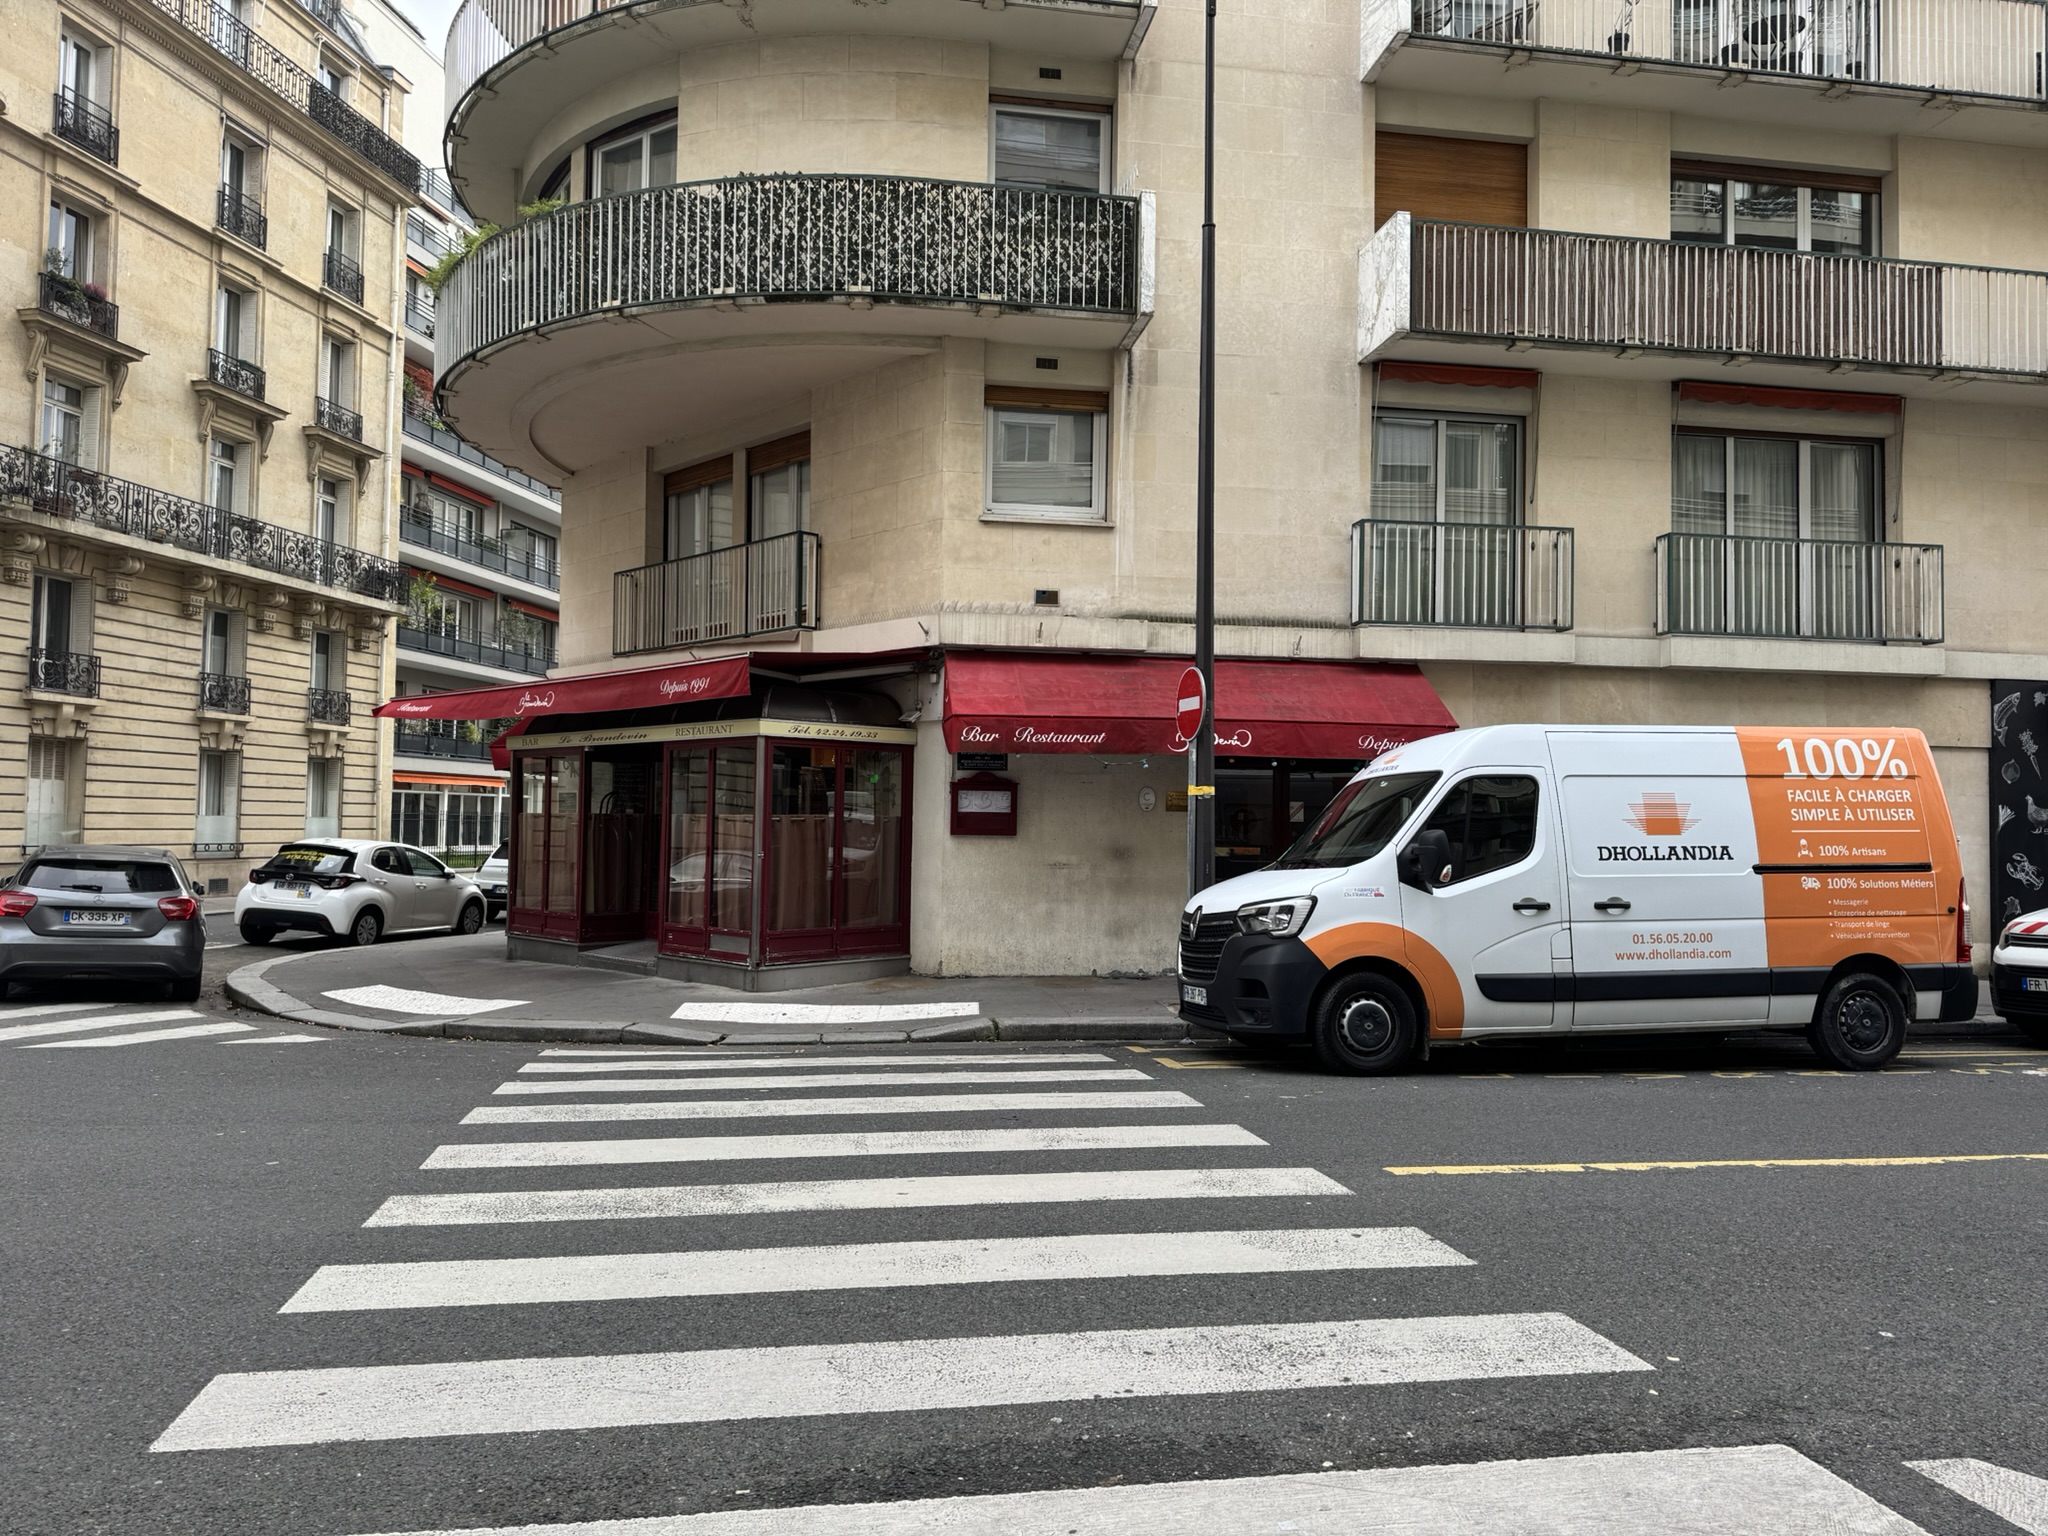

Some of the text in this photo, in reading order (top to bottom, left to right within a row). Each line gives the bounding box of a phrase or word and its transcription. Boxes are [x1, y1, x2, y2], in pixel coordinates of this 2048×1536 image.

[660, 676, 711, 699] Depuis 1991
[522, 738, 539, 747] BAR
[558, 735, 574, 744] Le
[675, 725, 734, 737] RESTAURANT
[961, 725, 1107, 743] Bar Restaurant
[1776, 738, 1908, 781] 100%
[1787, 786, 1912, 803] FACILE À CHARGER
[1790, 805, 1916, 821] SIMPLE À UTILISER
[1597, 845, 1734, 861] DHOLLANDIA
[1819, 845, 1887, 857] 100% Artisans
[1826, 877, 1934, 889] 100% Solutions Métiers
[1832, 899, 1869, 907] Messagerie
[1833, 909, 1866, 917] Entreprise
[1834, 920, 1890, 929] Transport de linge
[1632, 932, 1713, 944] 01.56.05.20.00
[1835, 931, 1866, 939] Véhicules
[1615, 949, 1732, 960] www.dhollandia.com
